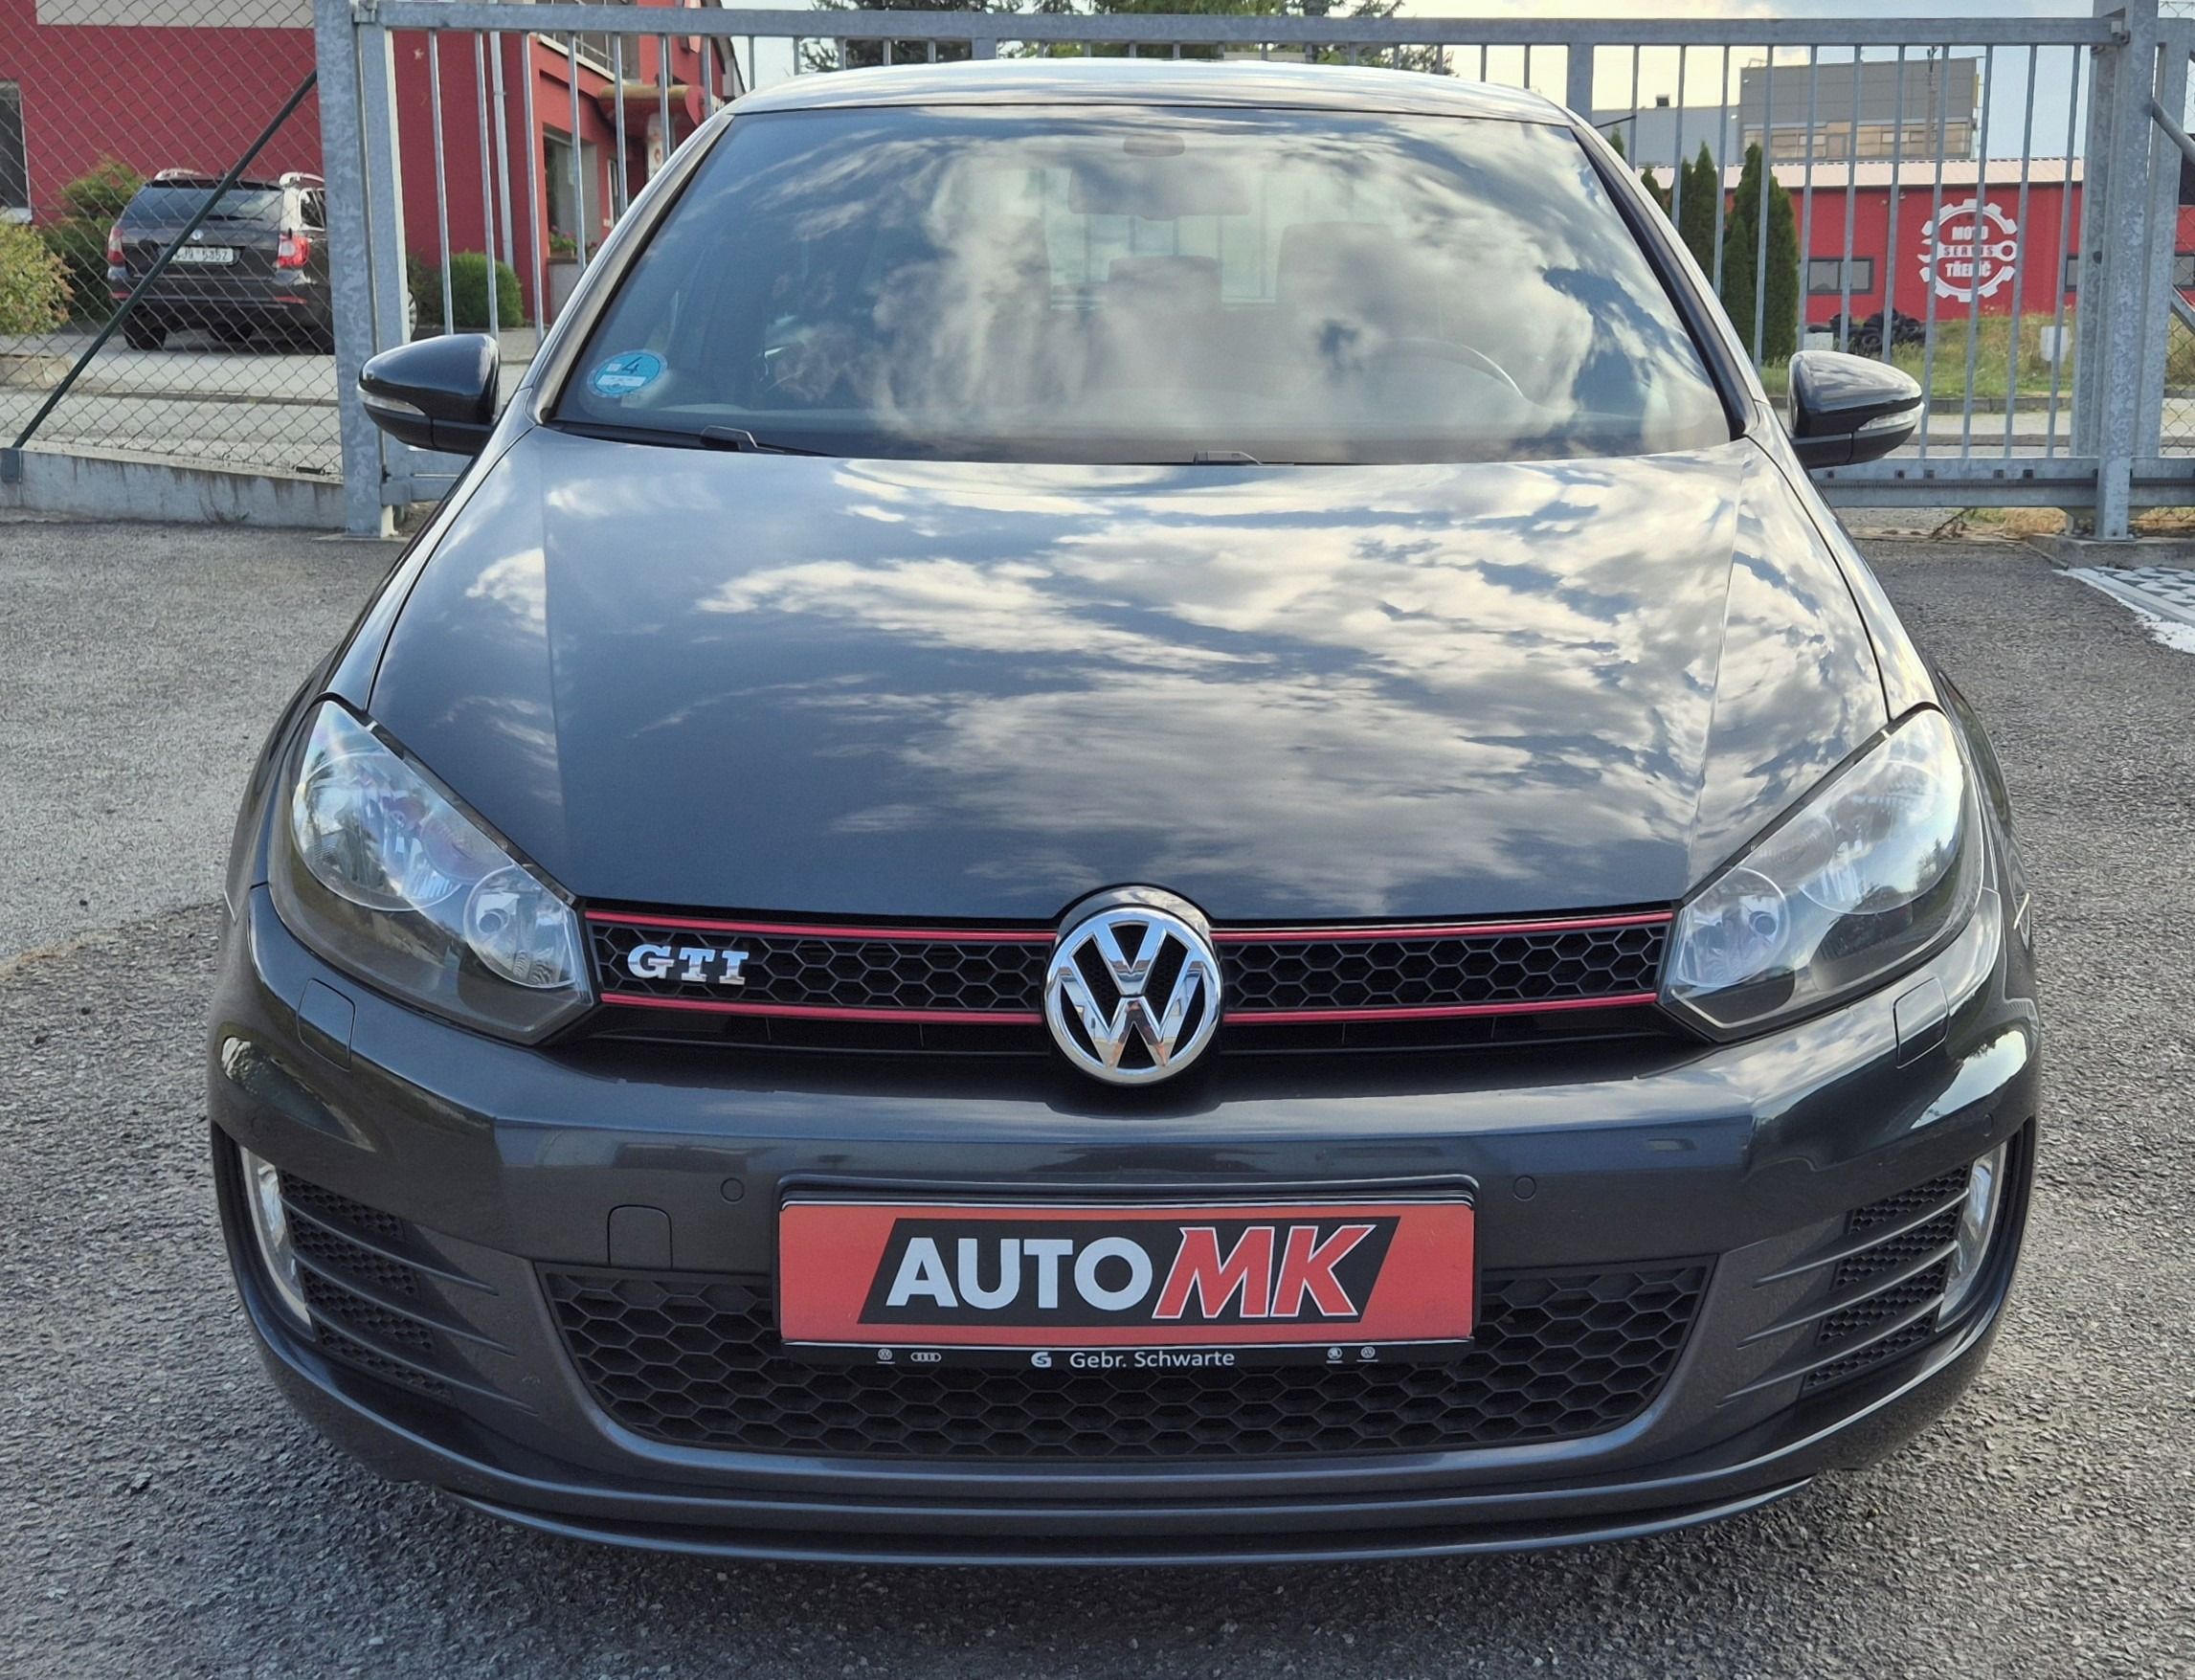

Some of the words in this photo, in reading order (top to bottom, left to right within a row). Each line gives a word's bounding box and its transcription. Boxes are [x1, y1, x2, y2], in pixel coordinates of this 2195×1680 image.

[1943, 246, 1993, 257] SERIS
[622, 356, 642, 373] 4
[627, 943, 750, 985] GTI
[1069, 1351, 1127, 1369] Gebr.
[1133, 1350, 1235, 1368] Schwarte
